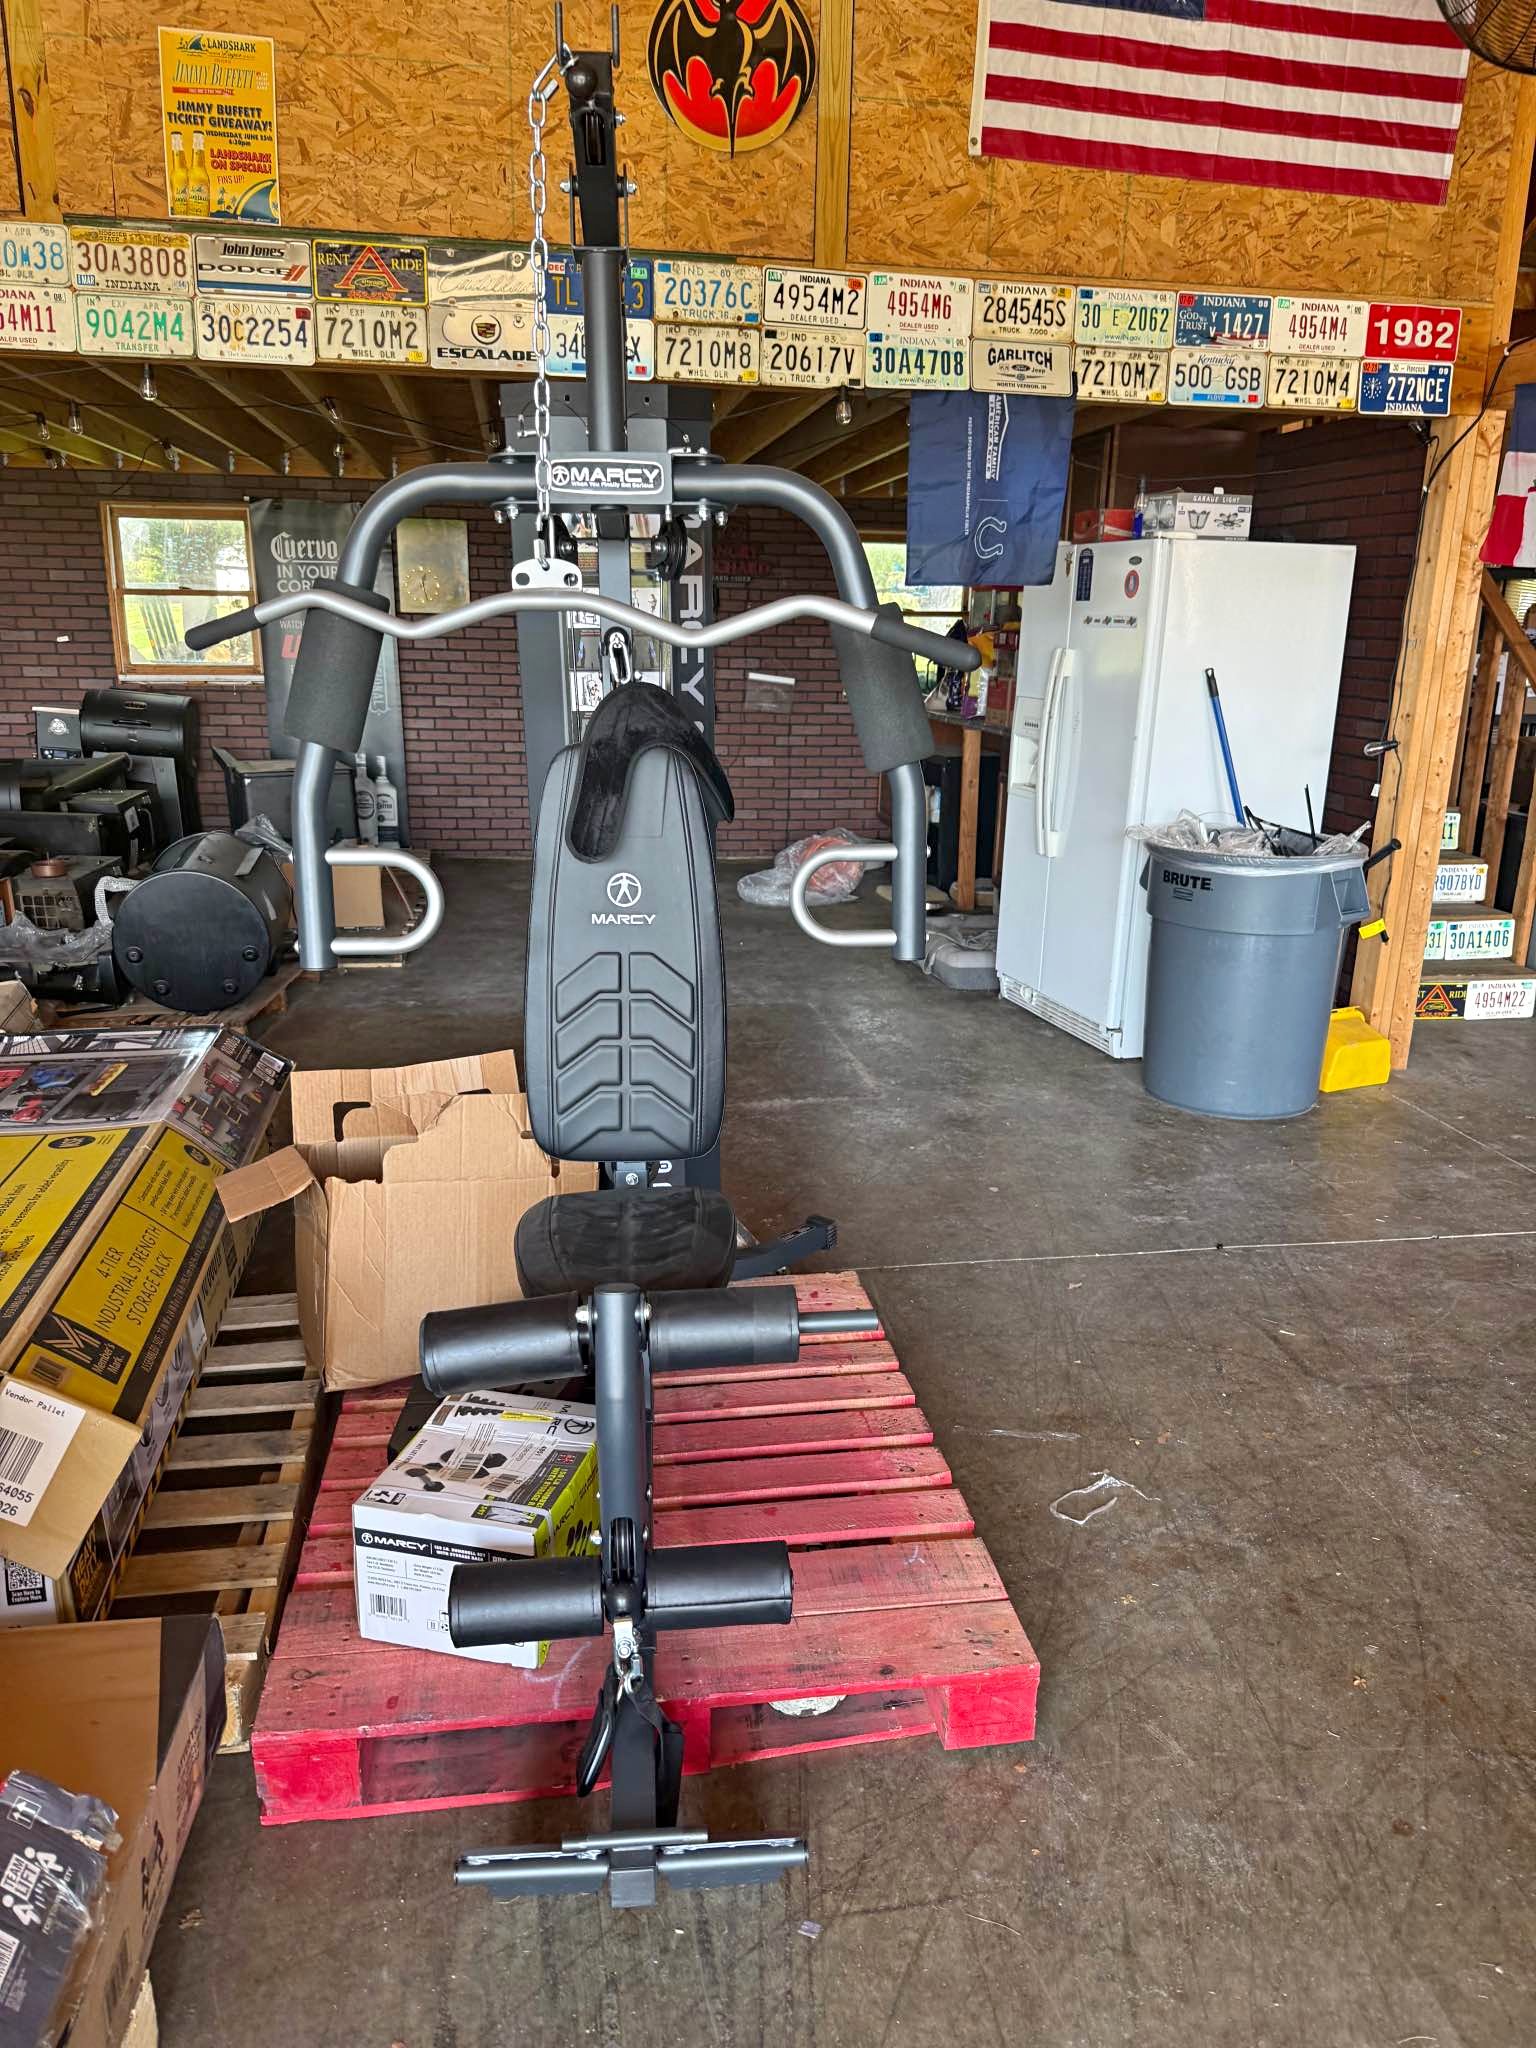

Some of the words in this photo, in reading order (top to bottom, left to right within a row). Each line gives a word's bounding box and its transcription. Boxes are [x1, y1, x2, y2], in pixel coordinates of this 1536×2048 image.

[207, 38, 256, 52] LANDSHARK
[173, 59, 209, 84] JIMMY
[211, 63, 255, 88] BUFFETT
[177, 100, 213, 114] JIMMY
[217, 104, 262, 118] BUFFETT
[167, 112, 205, 126] TICKET
[209, 116, 272, 132] GIVEAWAY!
[210, 148, 272, 163] LANDSHARK
[211, 159, 228, 170] ON
[229, 162, 272, 175] SPECIAL!
[217, 175, 233, 184] FINS
[223, 243, 249, 255] John
[251, 245, 285, 257] Jones
[77, 242, 186, 278] 30A3808
[318, 253, 350, 265] RENT
[334, 246, 408, 292] A
[391, 258, 423, 271] RIDE
[199, 263, 289, 276] DODGE
[683, 266, 703, 275] IND
[105, 280, 160, 291] INDIANA
[800, 275, 831, 285] INDIANA
[900, 279, 942, 290] INDIANA
[665, 278, 752, 309] 20376C
[774, 283, 859, 315] 4954M2
[1002, 285, 1047, 295] INDIANA
[1108, 292, 1144, 301] INDIANA
[228, 303, 281, 315] INDIANA
[888, 290, 952, 320] 4954M6
[984, 295, 1067, 327] 284545S
[1203, 296, 1247, 308] INDIANA
[1301, 303, 1340, 313] INDIANA
[380, 311, 395, 319] APR
[682, 308, 716, 319] TRUCK
[790, 314, 817, 322] DEALER
[820, 316, 839, 324] USED
[1081, 303, 1100, 328] 30
[1113, 309, 1120, 326] E
[1128, 306, 1169, 332] 2062
[1180, 310, 1199, 320] GOD
[86, 308, 184, 342] 9042M4
[202, 314, 307, 348] 30C2254
[324, 317, 418, 349] 7210M2
[999, 326, 1020, 334] TRUCK
[1179, 320, 1208, 330] TRUST
[1222, 312, 1263, 339] 1427
[1289, 314, 1347, 341] 4954M4
[1374, 318, 1454, 349] 1982
[791, 333, 807, 341] IND
[900, 336, 937, 346] INDIANA
[116, 342, 160, 352] TRANSFER
[351, 349, 374, 358] WHSL
[380, 350, 396, 358] DLR
[437, 347, 538, 361] ESCALADE
[665, 337, 751, 369] 7210M8
[770, 343, 854, 374] 20617V
[872, 346, 964, 376] 30A4708
[988, 347, 1053, 371] GARLITCH
[1197, 355, 1235, 365] Kentucky
[1321, 361, 1334, 369] APR
[688, 369, 709, 377] WHSL
[714, 370, 728, 378] DLR
[790, 373, 816, 383] TRUCK
[1081, 359, 1160, 389] 7210M7
[1175, 363, 1212, 388] 500
[1225, 366, 1261, 391] GSB
[1275, 368, 1350, 397] 7210M4
[1101, 389, 1119, 397] WHSL
[1386, 376, 1446, 403] 272NCE
[1385, 402, 1423, 412] INDIANA
[993, 395, 1002, 443] AMERICAN
[987, 400, 995, 473] INSURANCE
[990, 446, 999, 480] FAMILY
[570, 467, 659, 483] MARCY
[270, 531, 338, 563] Cuervo
[277, 565, 292, 579] IN
[1441, 866, 1468, 874] INDIANA
[1163, 870, 1212, 891] BRUTE
[591, 913, 656, 924] MARCY
[1450, 929, 1510, 950] 30A1406
[1475, 990, 1526, 1009] 4954M22
[96, 1246, 124, 1280] 4-TIER
[94, 1272, 137, 1334] INDUSTRIAL
[127, 1225, 162, 1273] STRENGTH
[126, 1275, 161, 1327] STORAGE
[155, 1250, 175, 1281] RACK
[91, 1342, 116, 1375] Member's
[5, 1388, 33, 1405] Vendor
[36, 1401, 65, 1417] Pallet
[374, 1536, 427, 1551] MARCY
[3, 1858, 24, 1889] TEAM
[14, 1866, 38, 1896] LIFT
